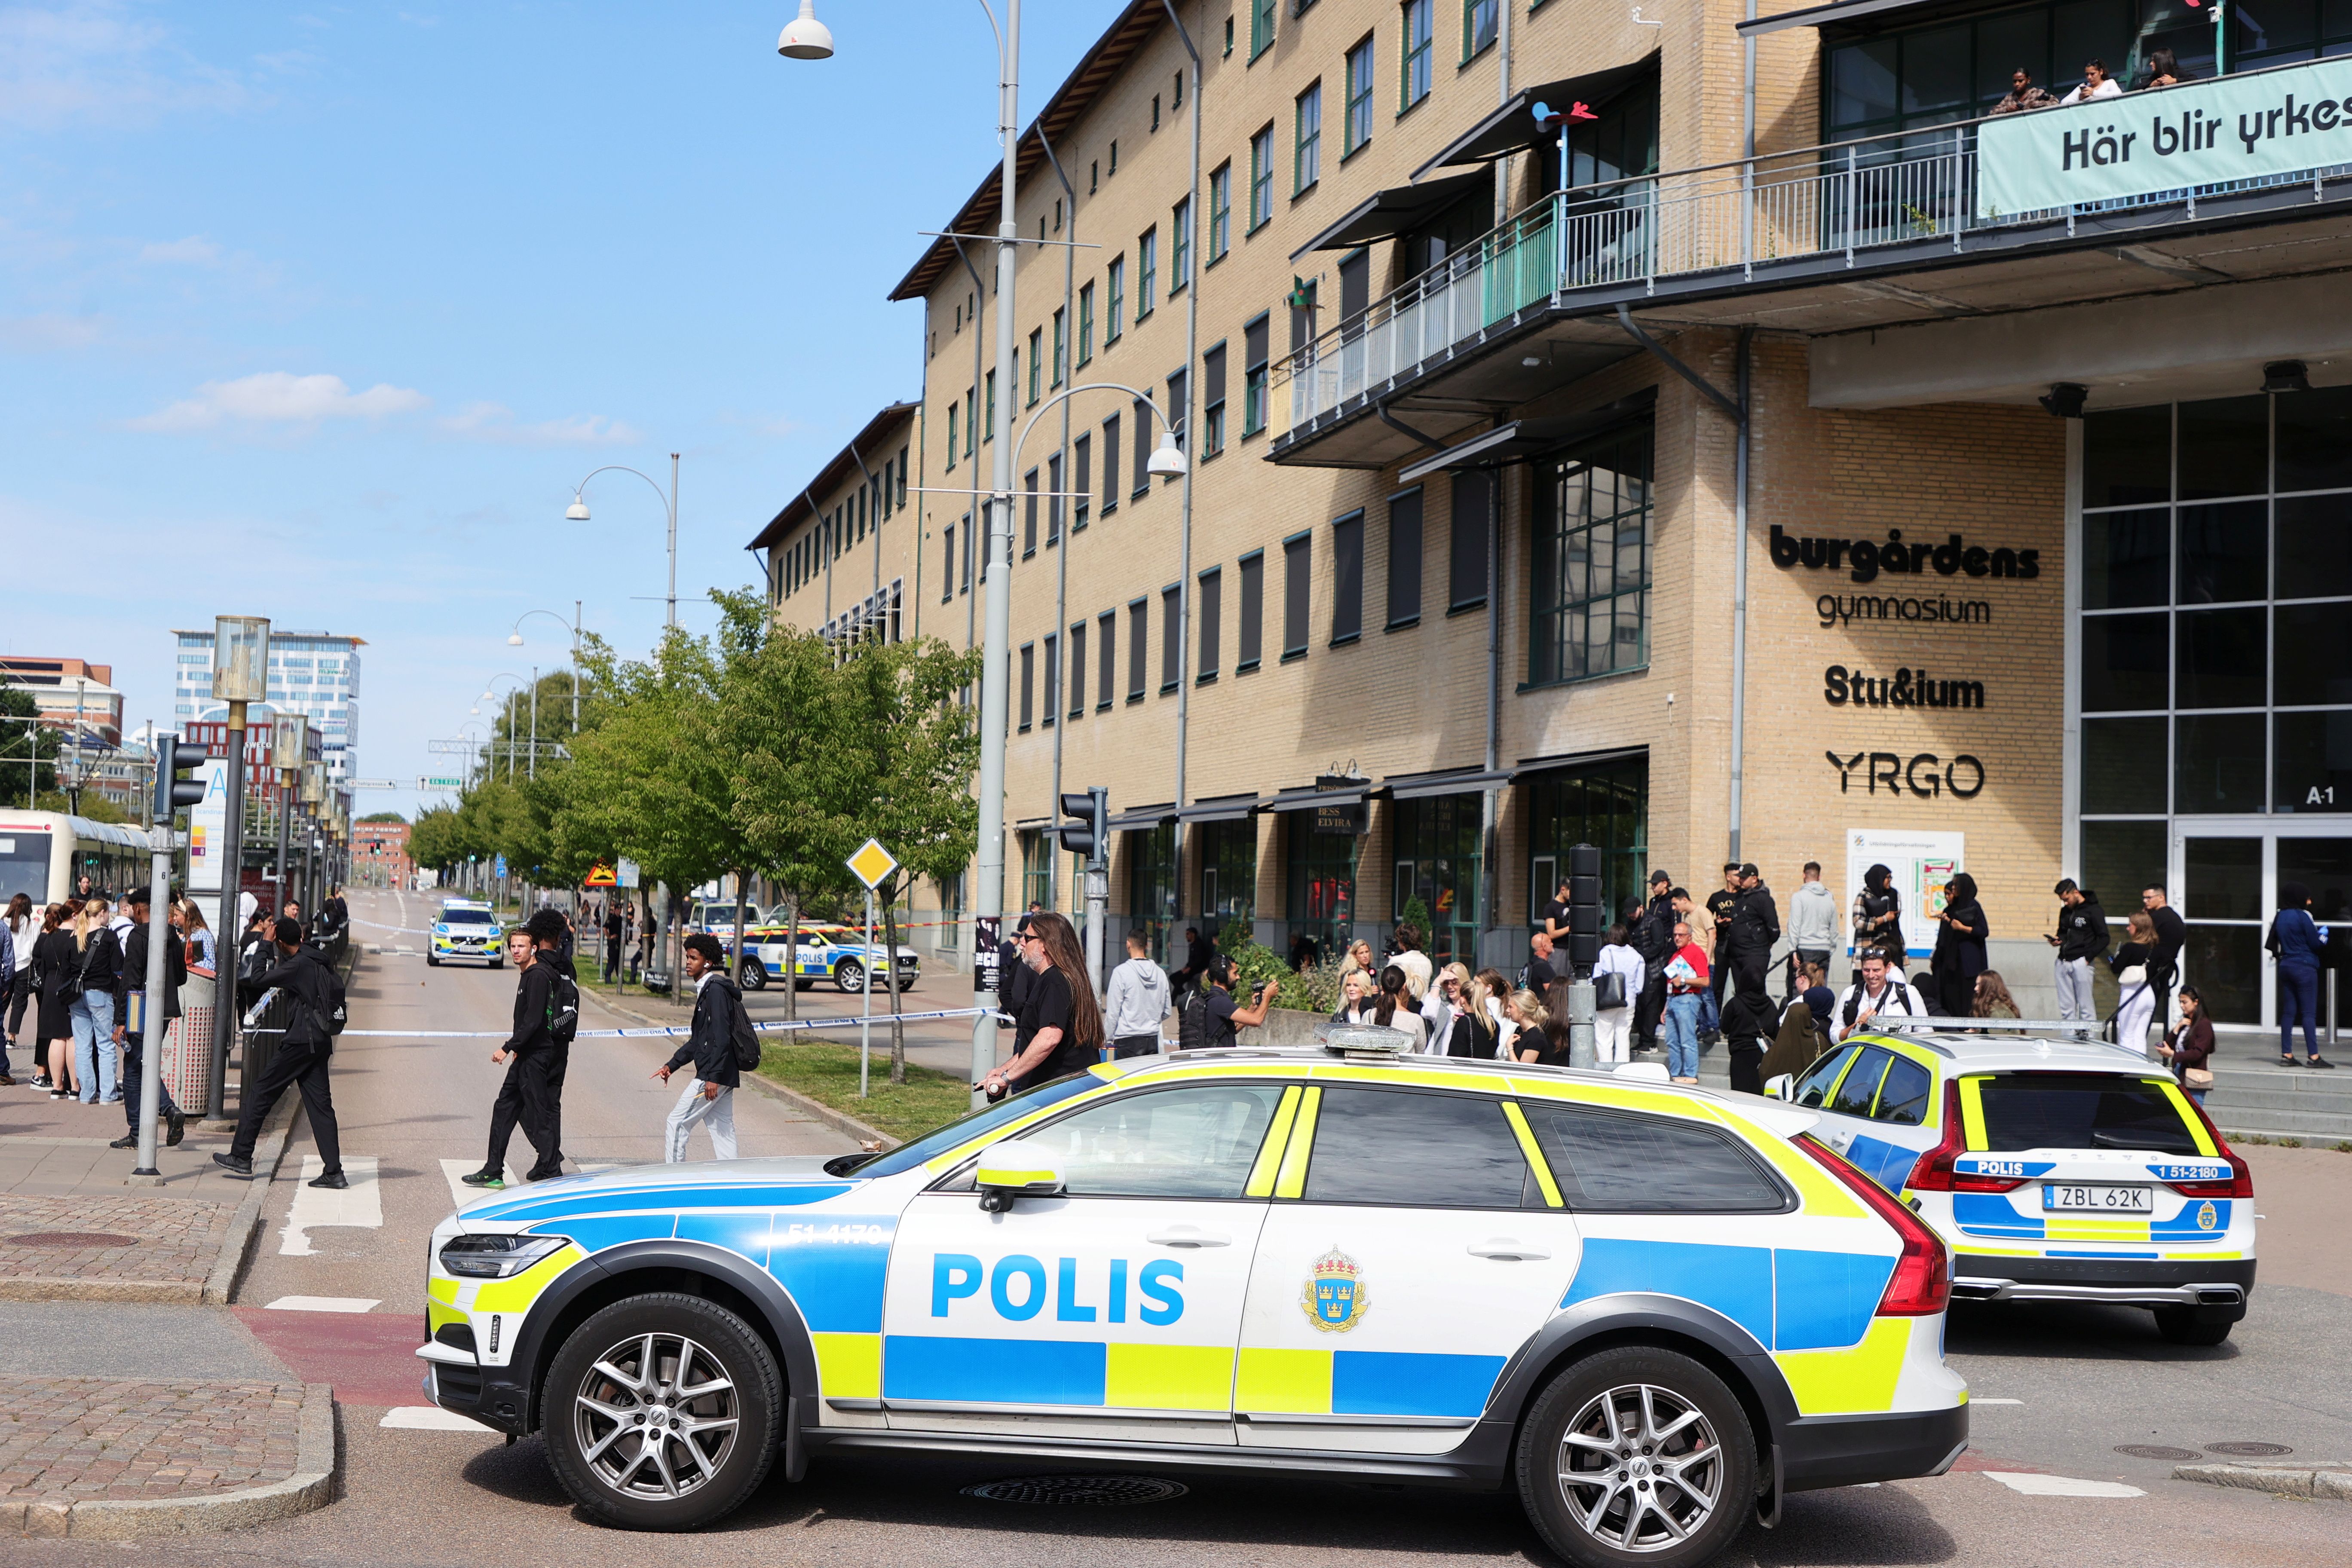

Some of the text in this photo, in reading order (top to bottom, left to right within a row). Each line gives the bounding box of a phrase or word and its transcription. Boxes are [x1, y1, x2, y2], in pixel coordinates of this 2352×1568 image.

[2063, 125, 2136, 171] Här
[2153, 109, 2222, 156] blir
[1770, 524, 2040, 583] burgårdens
[1816, 593, 1991, 628] gymnasium
[1825, 665, 1984, 708] Stu&ium
[245, 741, 272, 750] SWECO
[208, 767, 227, 798] A
[1826, 750, 1985, 798] YRGO
[2306, 786, 2334, 804] A-1
[1318, 807, 1340, 816] BESS
[1318, 818, 1351, 827] ELVIRA
[162, 871, 166, 880] 6
[796, 952, 823, 963] POLIS
[1978, 1161, 2023, 1176] POLIS
[2159, 1166, 2218, 1178] 1 51-2180
[2062, 1188, 2143, 1207] ZBL 62K
[931, 1253, 1185, 1326] POLIS
